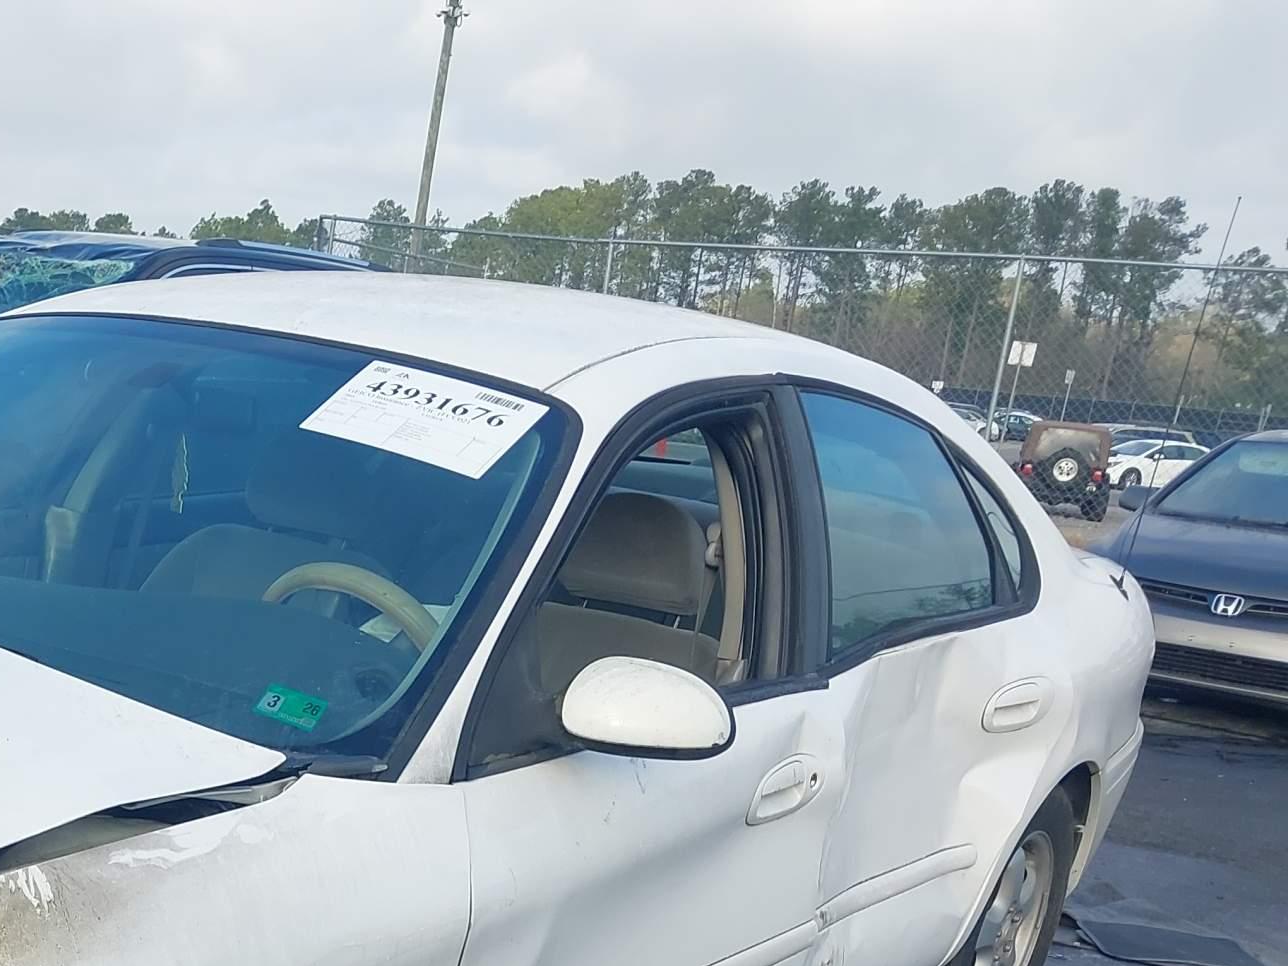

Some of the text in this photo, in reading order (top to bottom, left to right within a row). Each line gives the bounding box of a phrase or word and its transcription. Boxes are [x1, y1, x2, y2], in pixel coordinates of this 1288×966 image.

[365, 380, 506, 428] 43931676
[267, 694, 321, 717] 3 26
